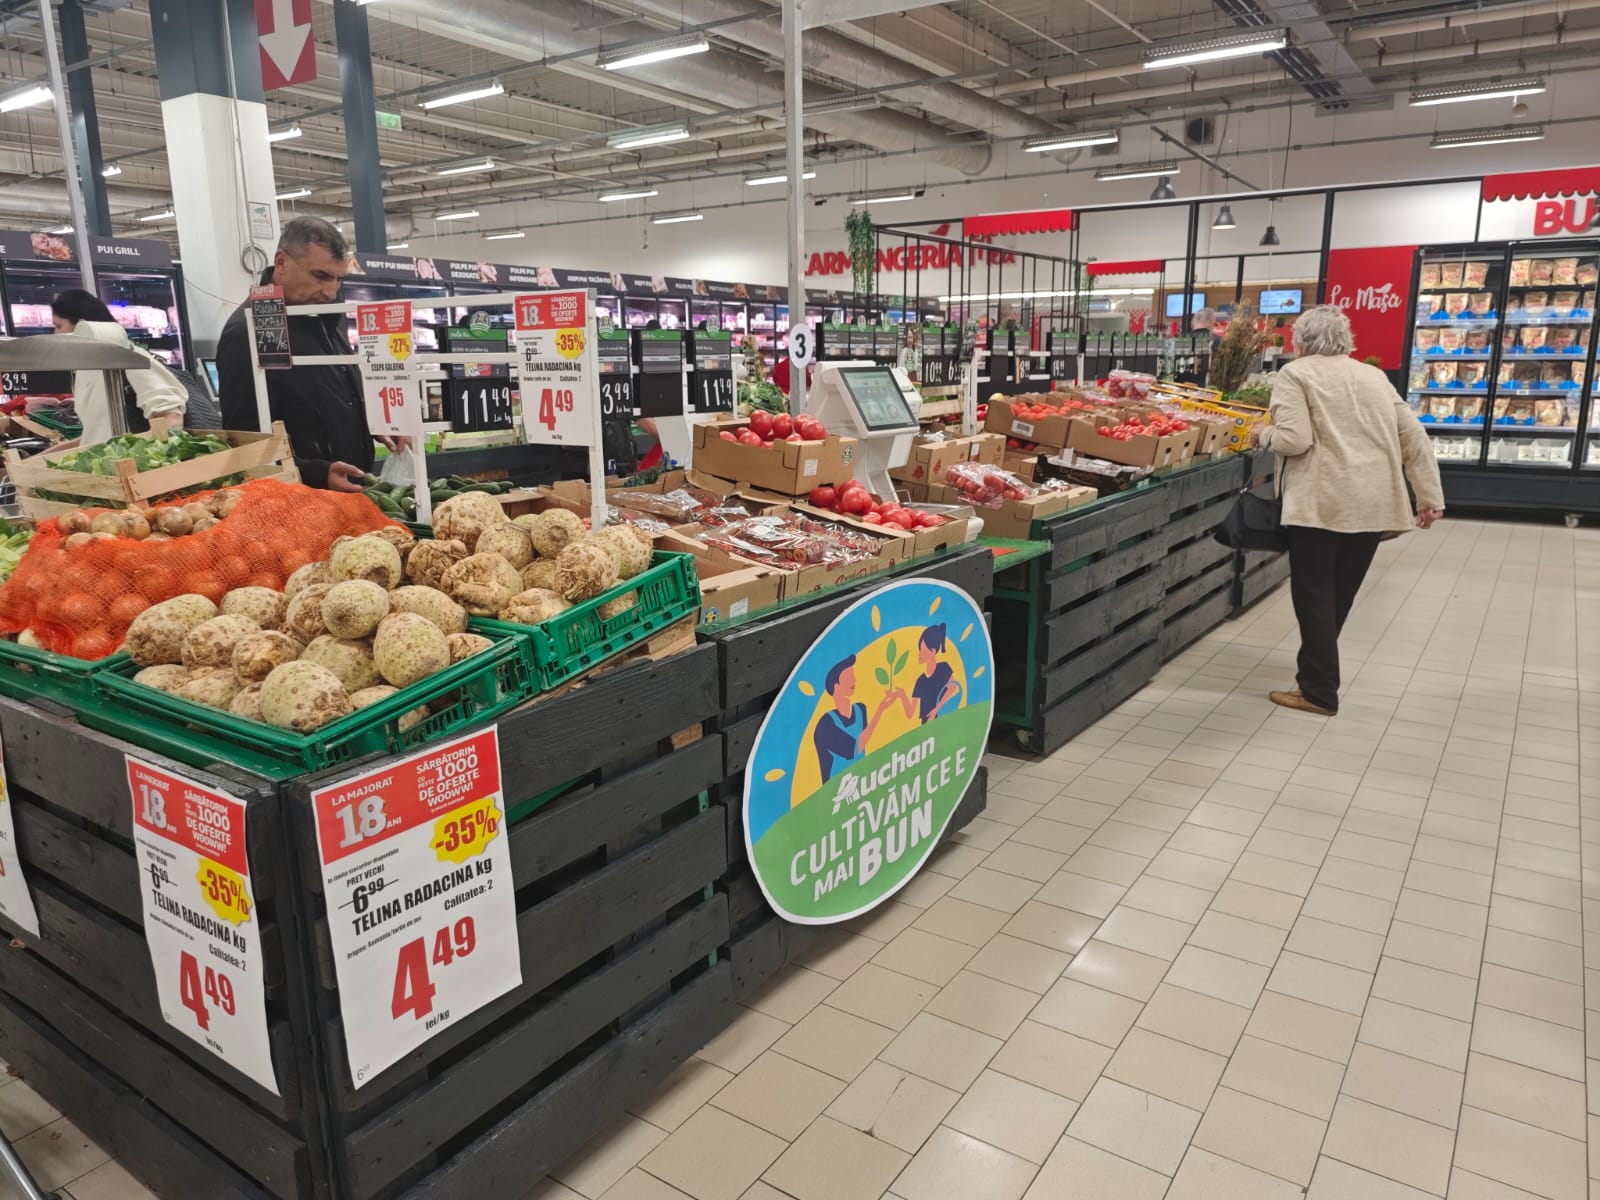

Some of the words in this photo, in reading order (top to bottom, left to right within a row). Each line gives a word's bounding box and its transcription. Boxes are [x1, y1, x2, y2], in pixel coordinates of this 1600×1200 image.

[1533, 197, 1597, 237] BU
[97, 245, 114, 254] PUI
[114, 246, 141, 256] GRILL
[521, 305, 539, 326] 18
[558, 302, 578, 310] 1000
[362, 314, 376, 332] 18
[390, 338, 411, 353] -27%
[556, 334, 584, 351] -35%
[795, 334, 806, 359] 3
[525, 362, 544, 372] TELINA
[544, 362, 572, 372] RADACINA
[574, 362, 582, 372] kg
[418, 779, 434, 789] PESTE
[436, 754, 478, 782] 1000
[418, 786, 434, 802] DE
[436, 768, 480, 794] OFERTE
[832, 736, 935, 816] Auchan
[331, 794, 346, 806] LA
[346, 776, 394, 800] MAJORAT
[427, 781, 474, 807] WOOWW!
[139, 784, 168, 828] 18
[197, 804, 231, 832] 1000
[186, 816, 198, 831] DE
[198, 822, 232, 846] OFERTE
[336, 795, 387, 848] 18
[386, 816, 402, 830] ANI
[435, 806, 497, 852] -35%
[814, 855, 854, 903] MAI
[858, 798, 933, 887] BUN
[346, 873, 363, 888] PRET
[364, 864, 385, 880] VECHI
[200, 868, 249, 916] -35%
[352, 898, 402, 936] TELINA
[404, 864, 474, 911] RADACINA
[475, 858, 492, 876] kg
[444, 884, 487, 911] Calitatea:
[487, 879, 494, 890] 2
[152, 888, 181, 919] TELINA
[182, 904, 231, 945] RADACINA
[233, 930, 246, 954] kg
[242, 960, 247, 972] 2
[426, 1010, 450, 1030] lei/kg
